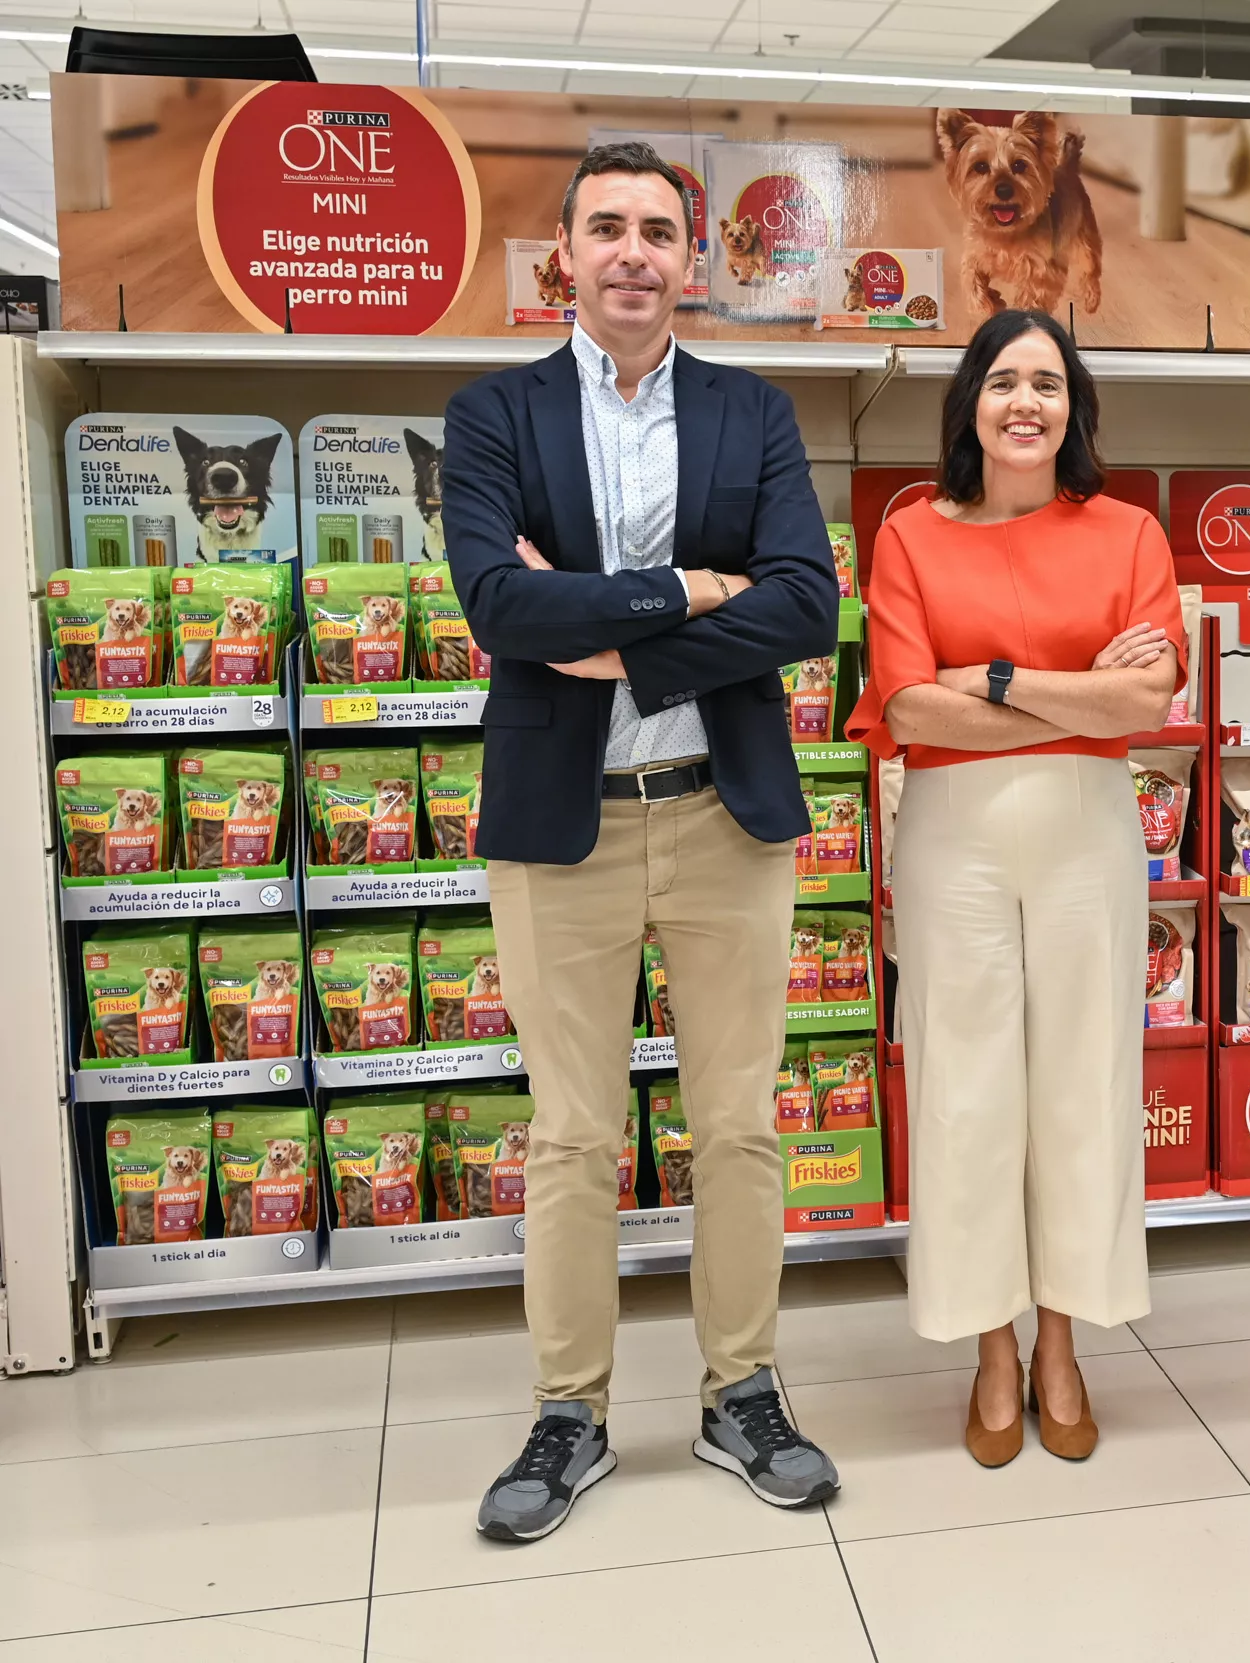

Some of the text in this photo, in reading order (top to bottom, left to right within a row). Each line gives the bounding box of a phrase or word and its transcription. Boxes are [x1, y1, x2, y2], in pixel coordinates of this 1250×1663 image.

[325, 113, 387, 126] PURINA
[279, 123, 396, 173] ONE
[283, 173, 319, 182] Resultados
[319, 174, 345, 183] Visibles
[346, 175, 360, 185] Hoy
[368, 175, 394, 183] Mañana
[313, 193, 367, 215] MINI
[262, 229, 429, 255] Elige nutrición
[249, 258, 443, 283] avanzada para tu
[289, 286, 408, 308] perro mini
[79, 434, 171, 453] Dentalife
[81, 461, 121, 472] ELIGE
[82, 473, 159, 484] SU RUTINA
[83, 485, 172, 495] DE LIMPIEZA
[84, 496, 139, 506] DENTAL
[145, 517, 163, 525] Daily
[60, 628, 96, 642] Friskies
[99, 646, 146, 656] FUNTASTIX
[102, 706, 125, 717] 2,12
[131, 705, 227, 717] la acumulación
[253, 700, 272, 715] 28
[116, 716, 215, 728] sarro en 28 días
[829, 750, 863, 760] SABOR!
[108, 891, 147, 903] Ayuda
[161, 890, 207, 900] reducir
[210, 888, 220, 898] la
[89, 899, 241, 913] acumulación de la placa
[835, 1007, 869, 1017] SABOR!
[99, 1069, 250, 1085] Vitamina D y Calcio para
[127, 1080, 224, 1094] dientes fuertes
[799, 1145, 832, 1154] PURINA
[795, 1162, 856, 1183] Friskies
[812, 1210, 851, 1220] PURINA
[152, 1249, 226, 1262] 1 stick al día
